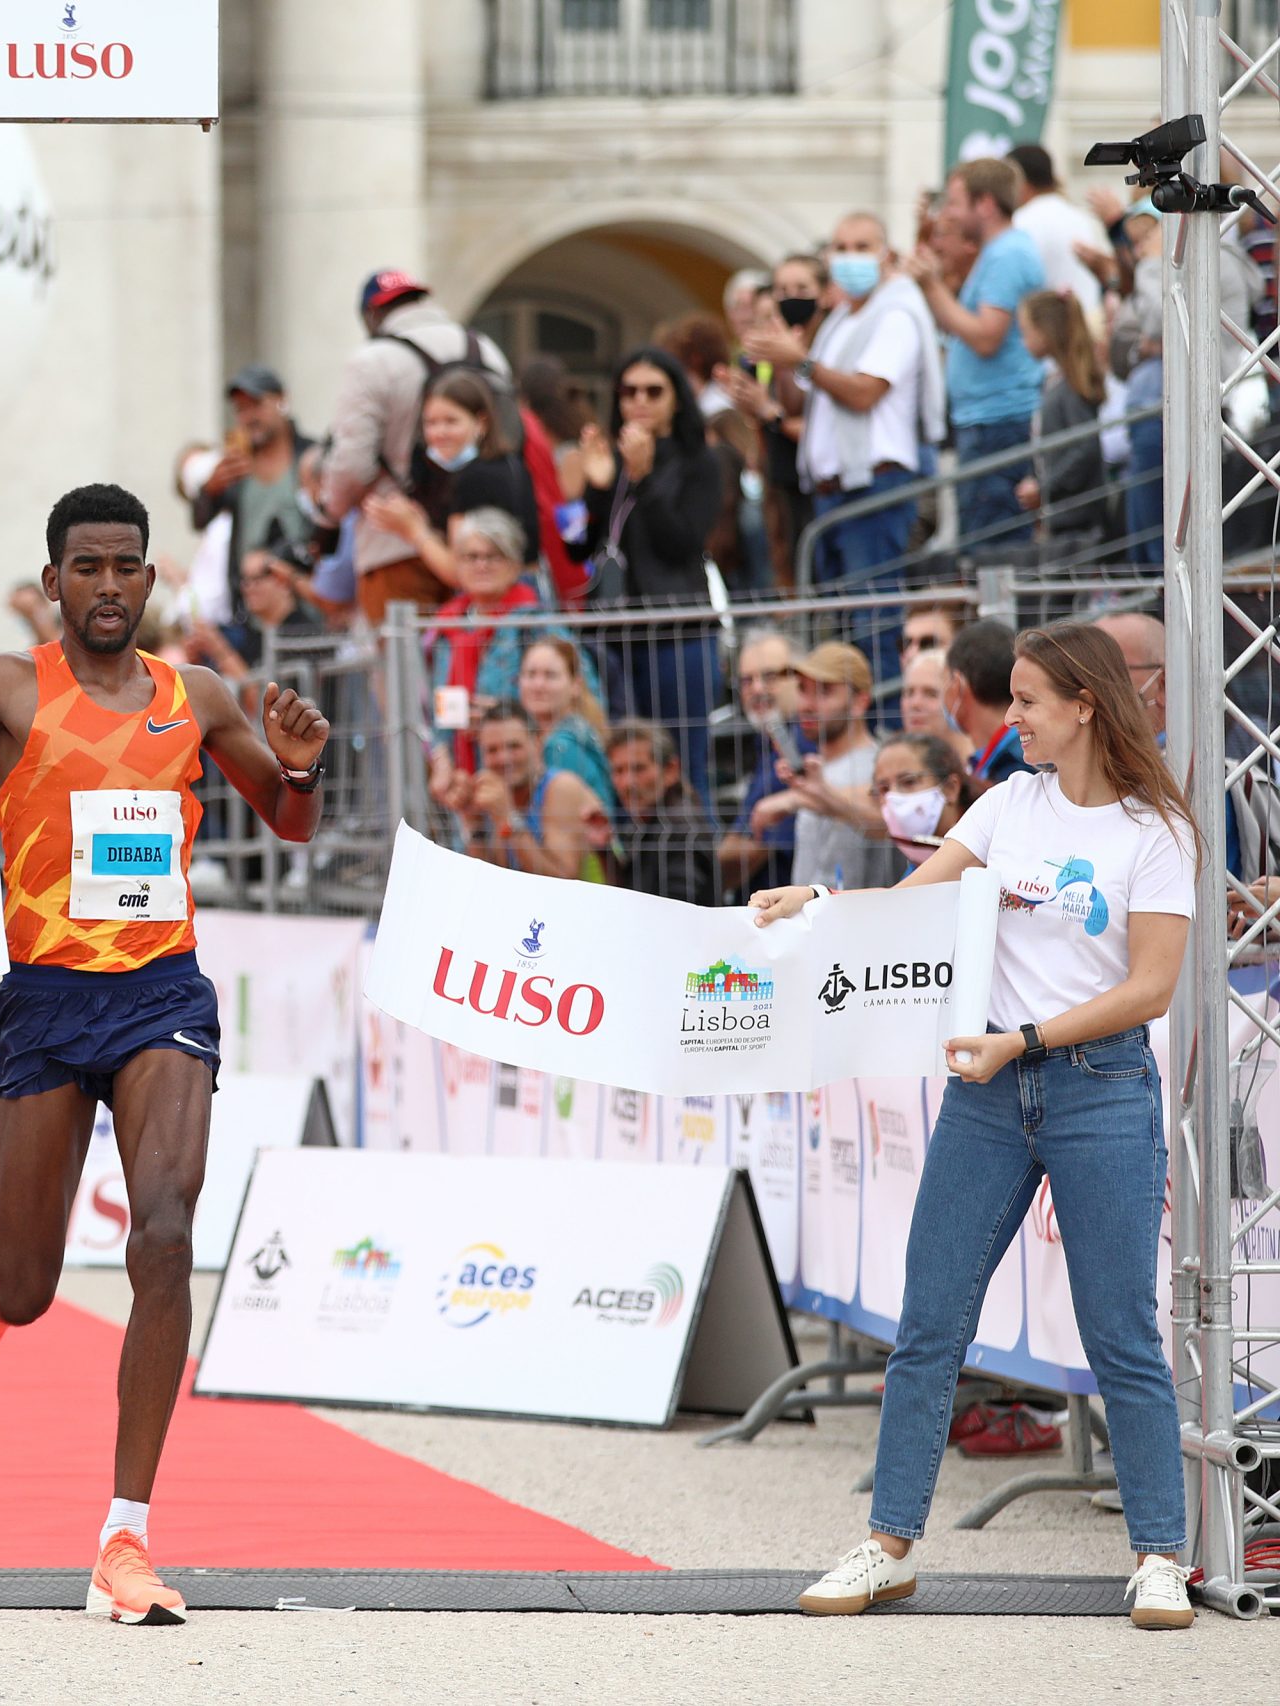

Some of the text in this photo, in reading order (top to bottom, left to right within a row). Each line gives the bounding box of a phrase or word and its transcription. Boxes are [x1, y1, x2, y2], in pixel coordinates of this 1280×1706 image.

[7, 42, 134, 79] LUSO
[113, 806, 157, 821] LUSO
[107, 847, 163, 863] DIBABA
[1017, 880, 1050, 896] LUSO
[118, 894, 149, 907] cme
[1064, 890, 1085, 903] MEIA
[516, 959, 538, 971] 1852
[864, 962, 953, 992] LISBO
[433, 946, 605, 1036] LUSO
[753, 1003, 773, 1011] 2021
[863, 998, 907, 1008] CÂMARA
[680, 1006, 770, 1032] Lisboa
[458, 1262, 538, 1290] aces
[450, 1288, 534, 1313] europe
[573, 1287, 655, 1313] ACES
